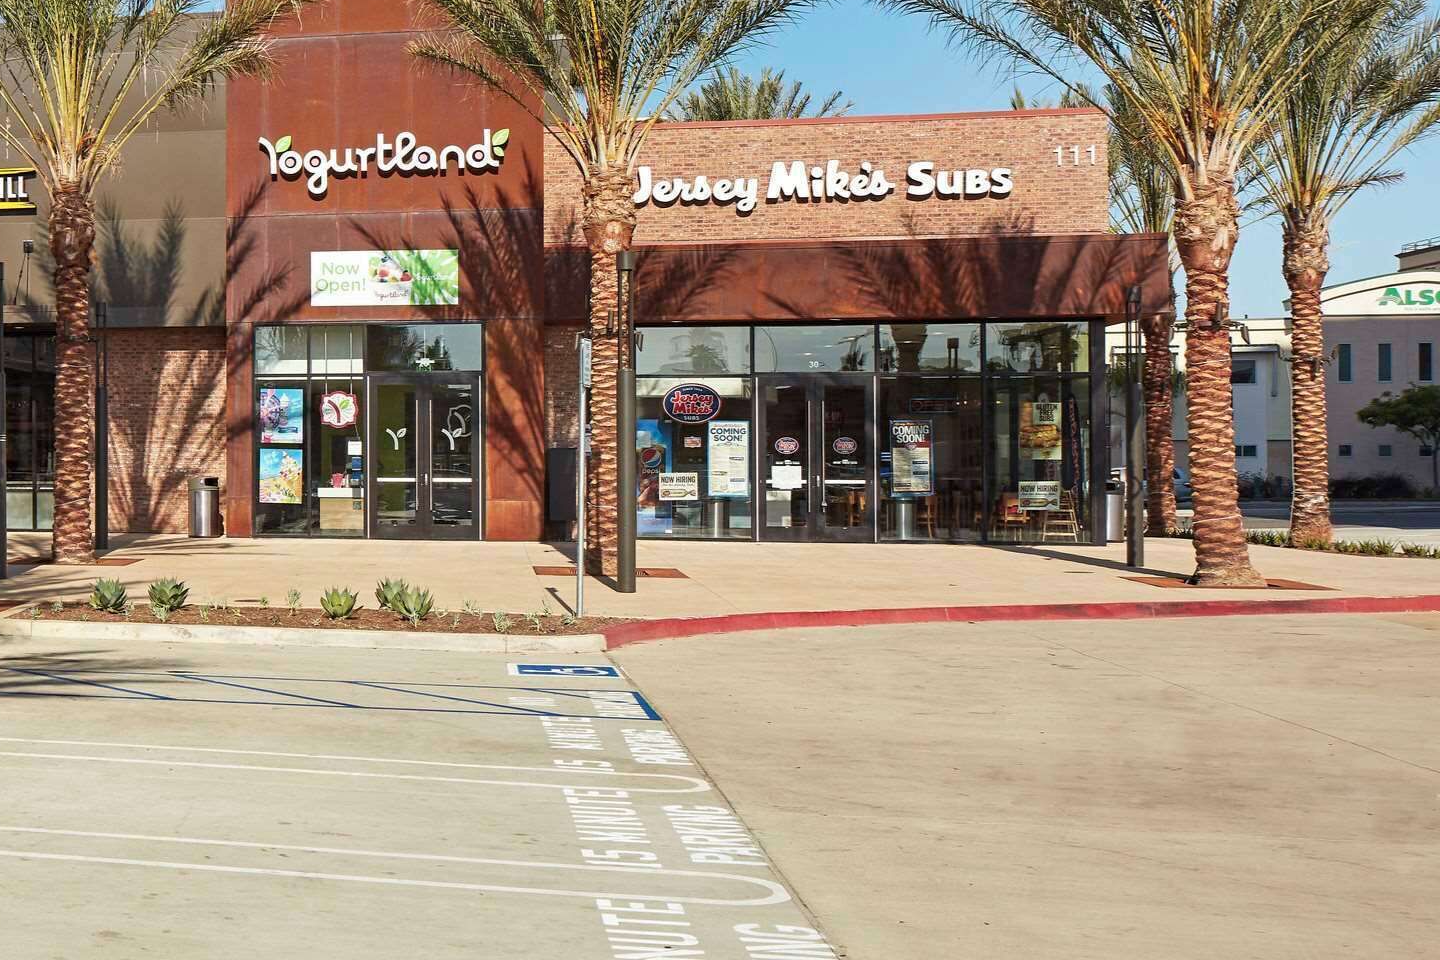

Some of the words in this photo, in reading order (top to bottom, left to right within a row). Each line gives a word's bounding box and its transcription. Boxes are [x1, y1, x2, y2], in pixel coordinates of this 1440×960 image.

[257, 128, 502, 195] Yogurtland
[1052, 144, 1097, 167] 111
[631, 165, 758, 212] Jersey
[766, 159, 895, 200] Mike's
[321, 262, 360, 275] Now
[315, 278, 367, 294] Open!
[670, 390, 714, 407] Jersey
[709, 427, 748, 436] COMING
[712, 434, 744, 443] SOON!
[892, 425, 930, 436] COMING
[896, 433, 926, 444] SOON!
[660, 475, 675, 484] NOW
[676, 475, 697, 484] HIRING
[1020, 484, 1036, 493] NOW
[1036, 484, 1058, 493] HIRING
[562, 788, 652, 844] MINUTE
[661, 804, 769, 866] PARKING
[580, 848, 662, 868] 15
